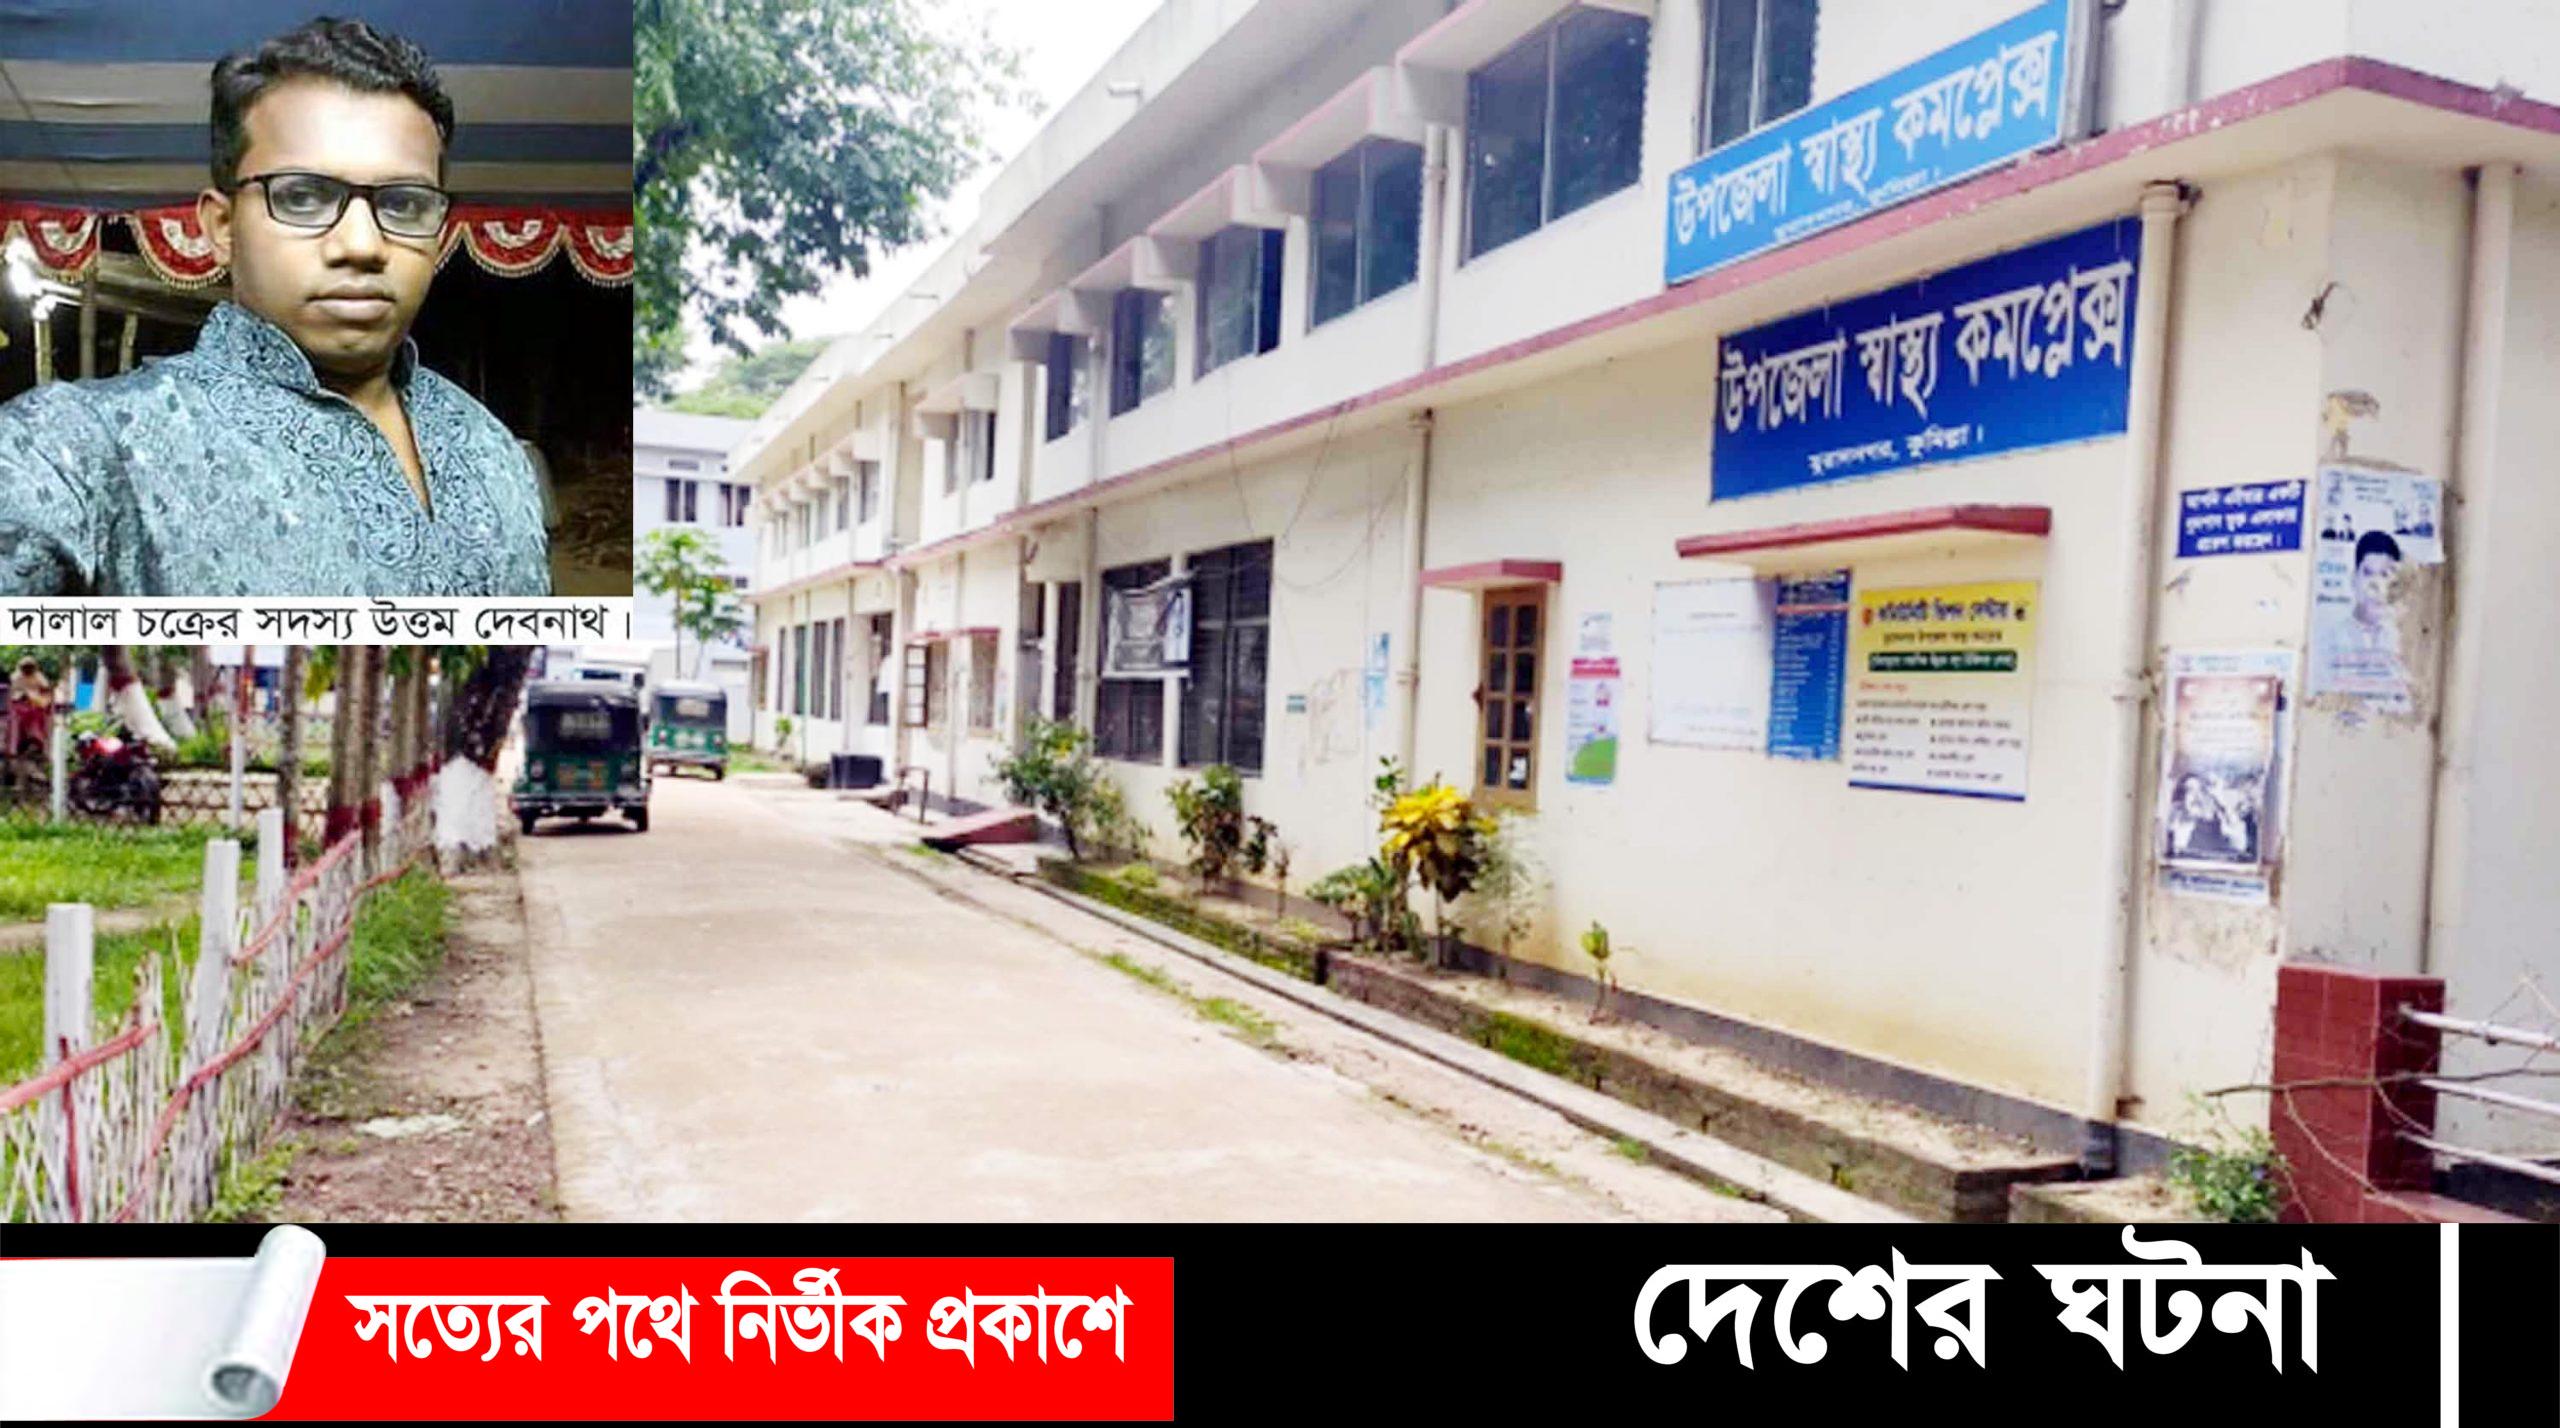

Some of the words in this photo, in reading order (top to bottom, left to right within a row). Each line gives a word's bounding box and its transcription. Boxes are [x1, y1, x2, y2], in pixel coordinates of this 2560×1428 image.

[1672, 140, 1792, 246] উপজেলা
[1799, 106, 1884, 196] স্বাস্থ্য
[1892, 30, 2058, 163] কমপ্লেক্স
[1721, 328, 1847, 434] উপজেলা
[1855, 311, 1946, 420] স্বাস্থ্য
[1953, 256, 2135, 387] কমপ্লেক্স
